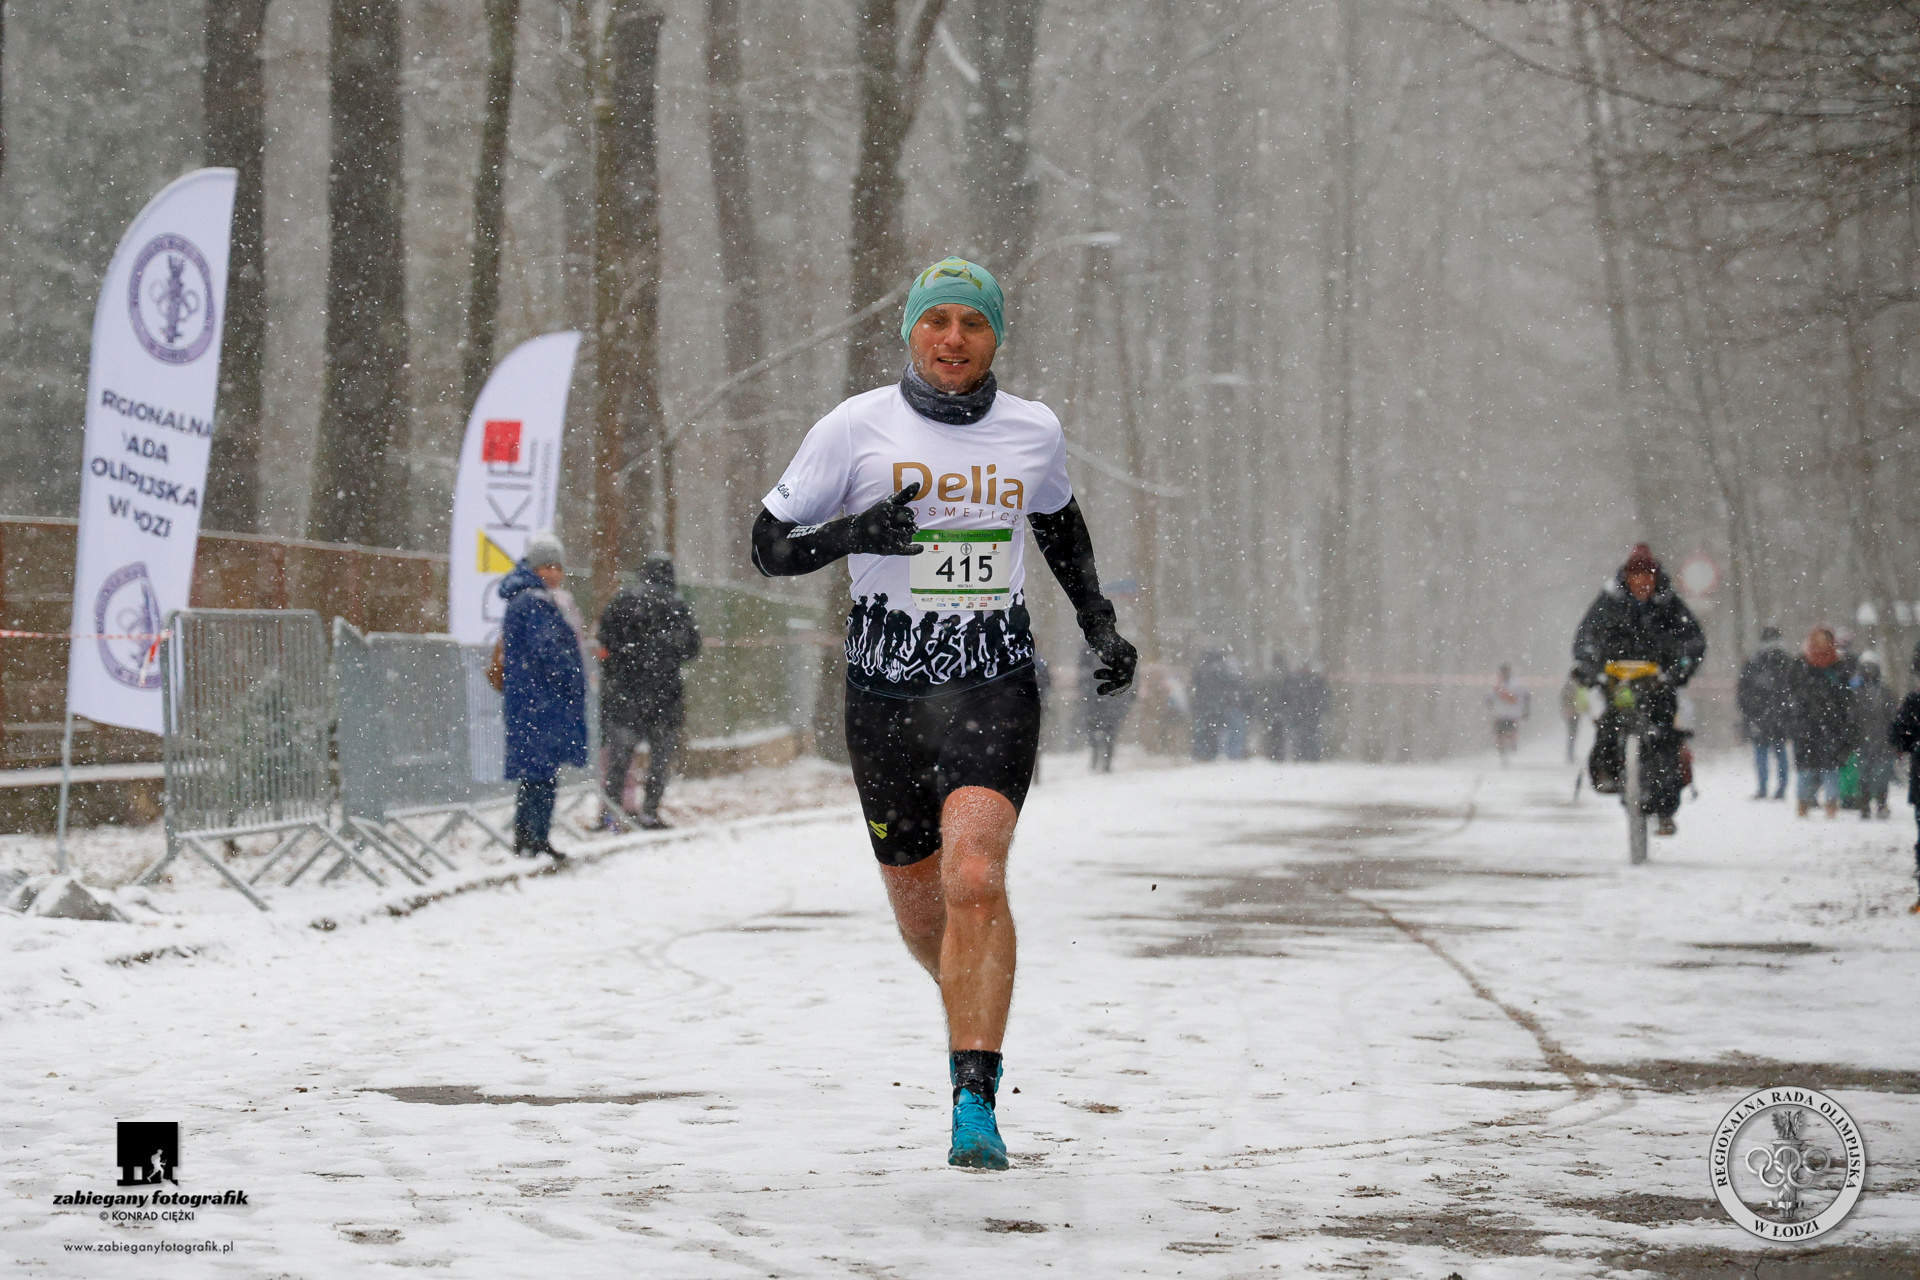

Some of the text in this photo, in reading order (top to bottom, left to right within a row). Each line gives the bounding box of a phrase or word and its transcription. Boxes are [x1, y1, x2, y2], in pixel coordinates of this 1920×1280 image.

[102, 390, 212, 437] RGIONALNA
[122, 430, 169, 463] ADA
[91, 457, 198, 509] OLIPIJSKA
[893, 461, 1024, 510] Delia
[913, 506, 1019, 525] SMETICS
[935, 555, 993, 583] 415
